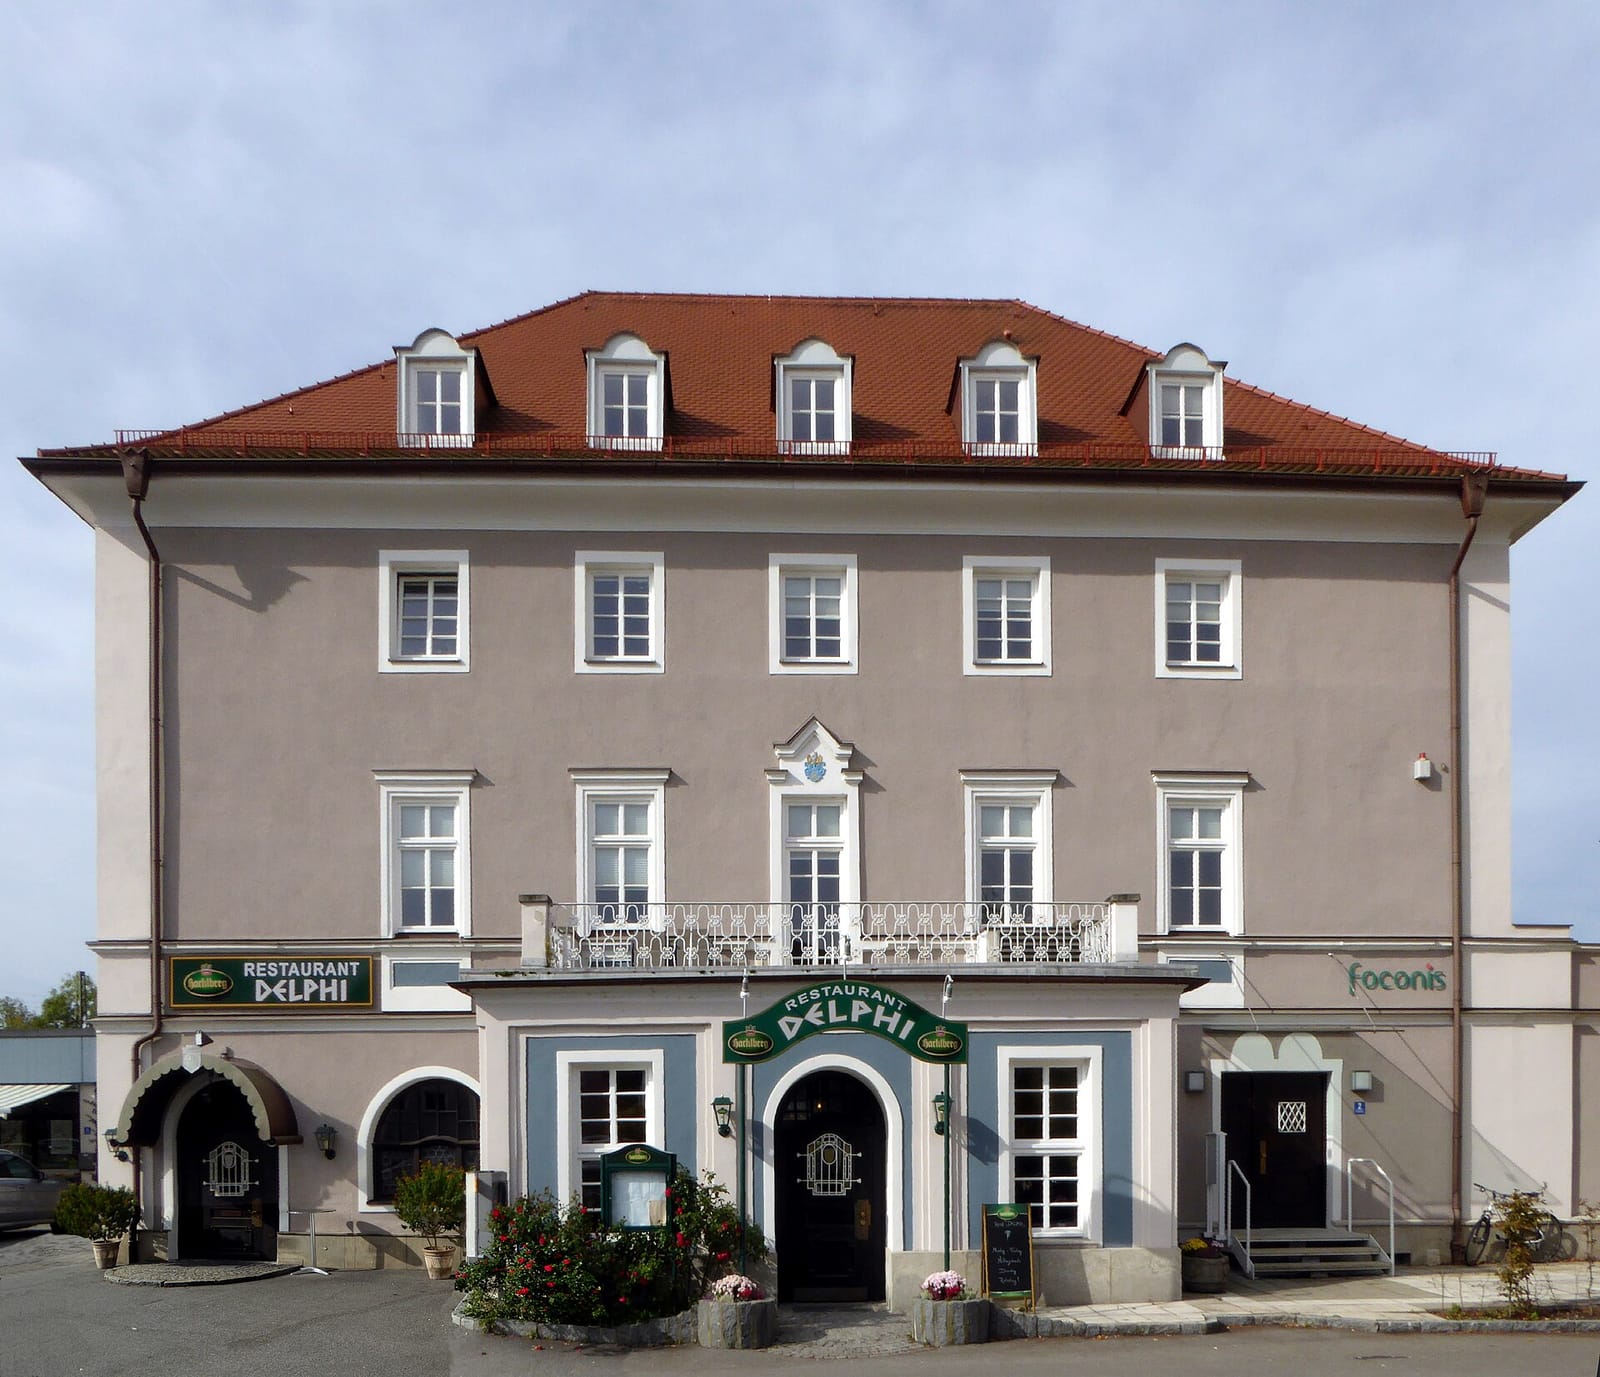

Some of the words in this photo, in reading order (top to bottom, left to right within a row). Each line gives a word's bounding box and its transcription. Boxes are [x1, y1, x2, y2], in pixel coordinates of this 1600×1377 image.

[244, 962, 360, 977] RESTAURANT
[1349, 962, 1447, 996] foconis
[255, 979, 347, 1002] DELPHI
[785, 985, 908, 1012] RESTAURANT
[778, 1000, 916, 1041] DELPHI
